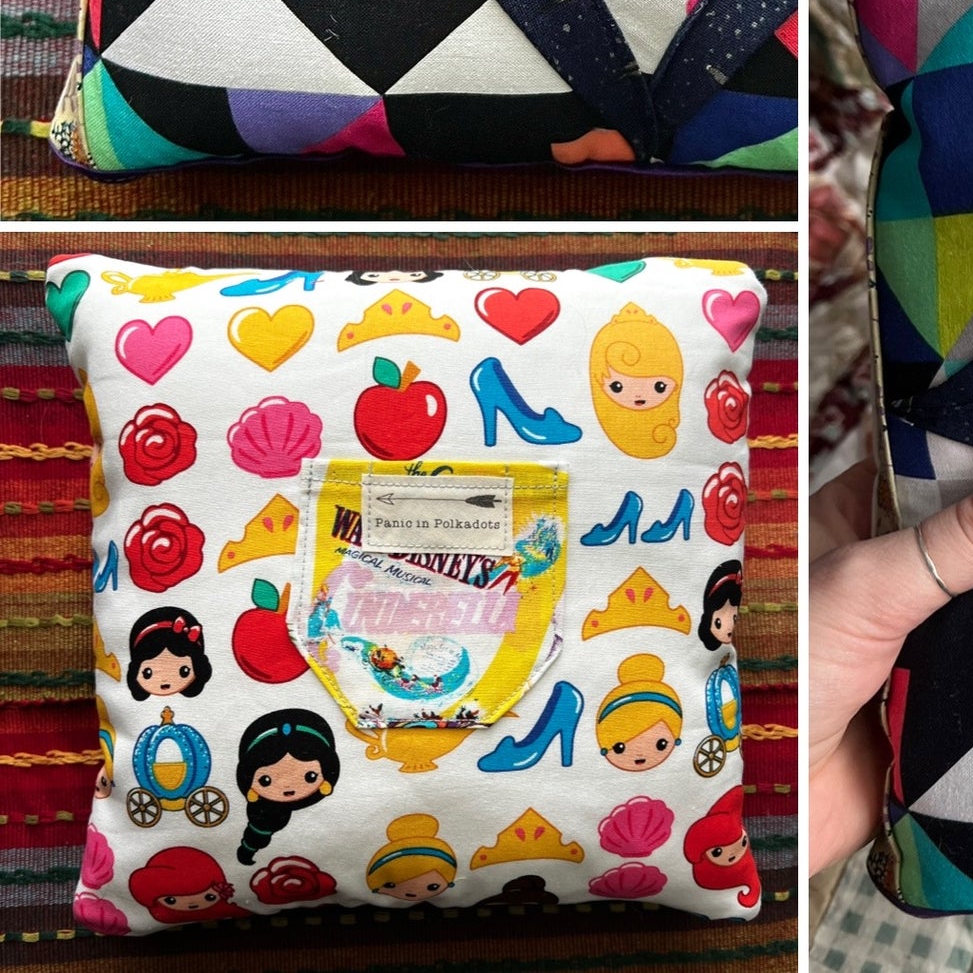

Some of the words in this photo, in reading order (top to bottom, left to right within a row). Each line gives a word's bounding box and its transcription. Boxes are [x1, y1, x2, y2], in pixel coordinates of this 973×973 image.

[375, 517, 413, 529] Panic
[416, 518, 430, 529] in
[434, 518, 501, 531] Polkadots
[334, 546, 383, 569] MAGICAL
[384, 564, 432, 587] MUSICAL
